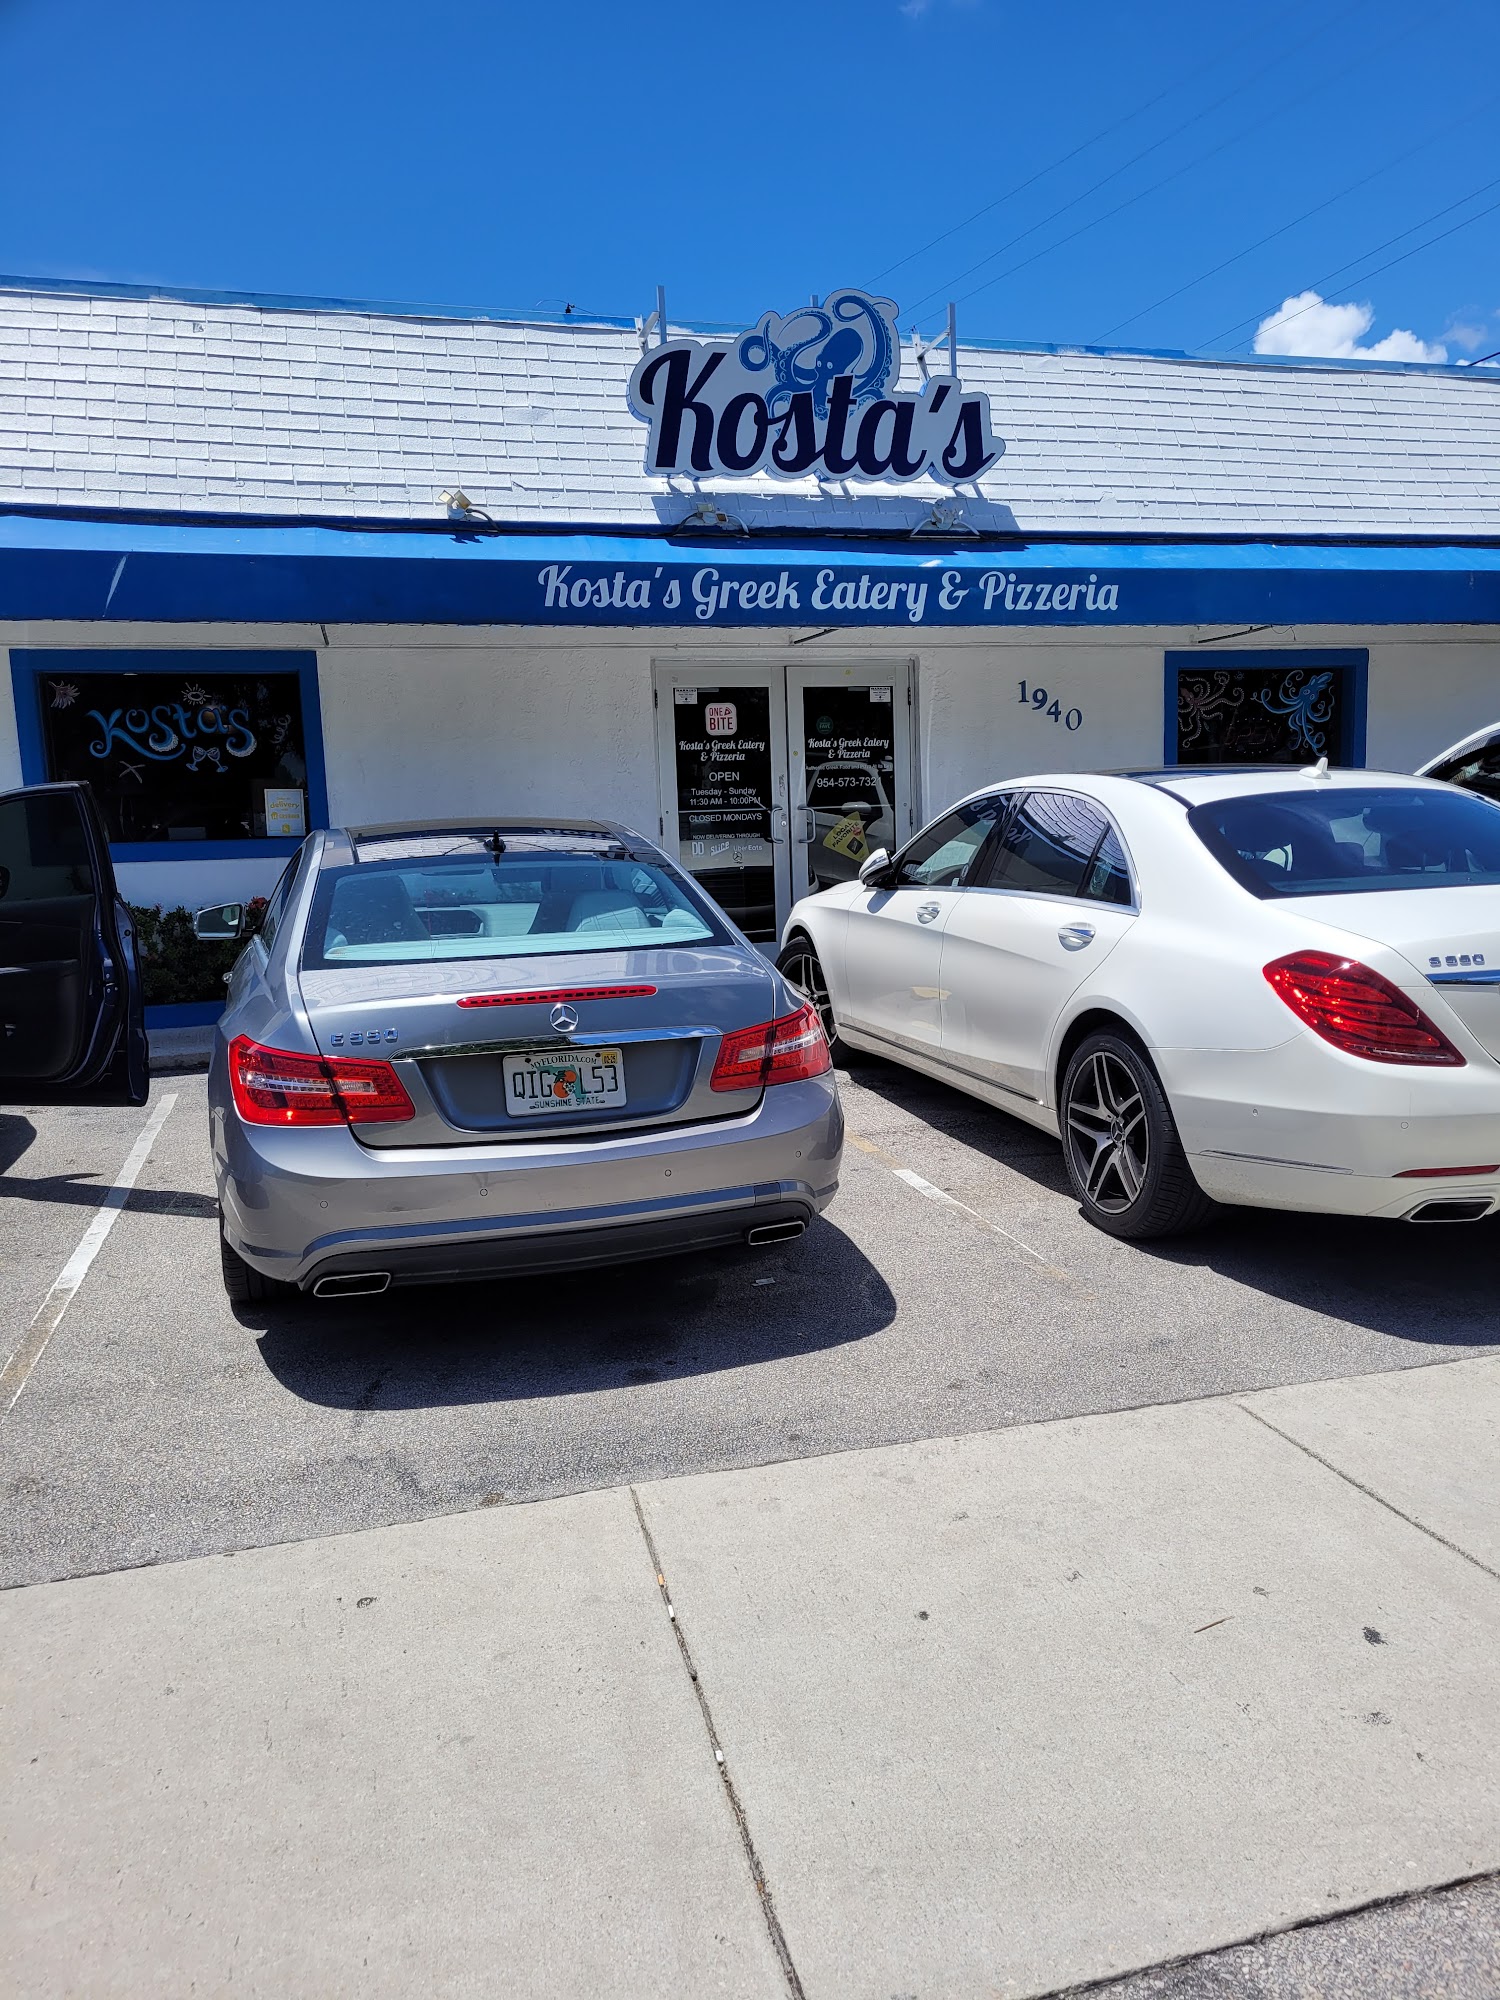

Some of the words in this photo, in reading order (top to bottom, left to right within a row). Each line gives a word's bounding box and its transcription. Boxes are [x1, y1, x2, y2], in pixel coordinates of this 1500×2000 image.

[639, 348, 996, 478] Kosta's
[538, 565, 681, 609] Kosta's
[691, 568, 801, 620] Greek
[811, 569, 929, 622] Eatery
[938, 570, 970, 610] &
[978, 570, 1120, 611] Pizzeria
[1018, 679, 1083, 731] 1940
[709, 707, 723, 716] ONE
[709, 717, 734, 730] BITE
[679, 741, 710, 751] Kosta's
[711, 740, 736, 751] Greek
[738, 740, 765, 752] Eatery
[808, 738, 838, 749] Kosta's
[838, 738, 862, 750] Greek
[863, 737, 889, 749] Eatery
[700, 752, 708, 761] &
[710, 752, 745, 761] Pizzeria
[828, 749, 835, 758] &
[837, 749, 870, 759] Pizzeria
[709, 771, 740, 781] OPEN
[691, 788, 722, 797] Tuesday
[729, 787, 756, 795] Sunday
[270, 800, 300, 809] delivery
[690, 798, 709, 806] 11:30
[689, 814, 721, 823] CLOSED
[723, 813, 762, 821] MONDAYS
[832, 821, 860, 848] FAVORITE
[833, 822, 853, 840] LOCAL
[530, 1054, 597, 1069] MYFLORIDA.COM
[535, 1098, 572, 1108] SUNSHINE
[575, 1096, 600, 1105] STATE
